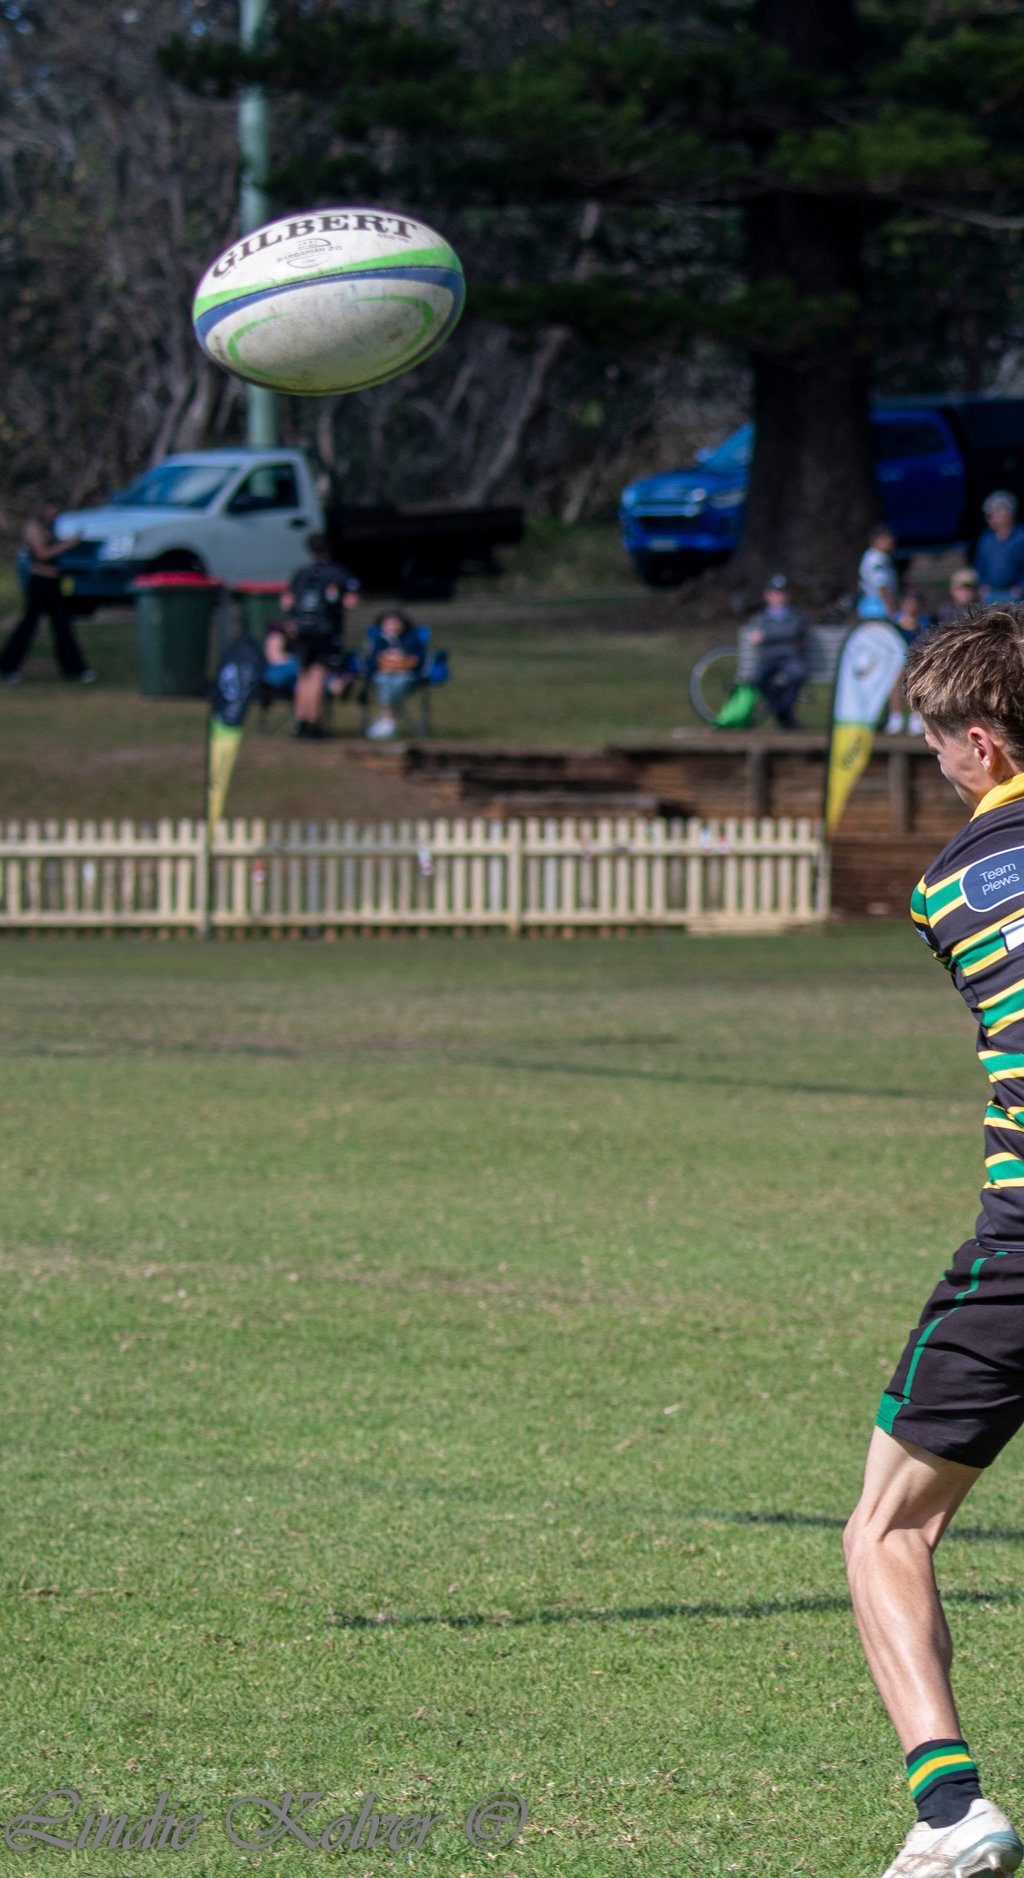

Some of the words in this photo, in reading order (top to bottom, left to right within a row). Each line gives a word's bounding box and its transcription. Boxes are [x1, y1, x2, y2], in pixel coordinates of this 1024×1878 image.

[211, 214, 417, 279] GILBERT
[979, 862, 1017, 882] Team
[981, 873, 1020, 896] Plews
